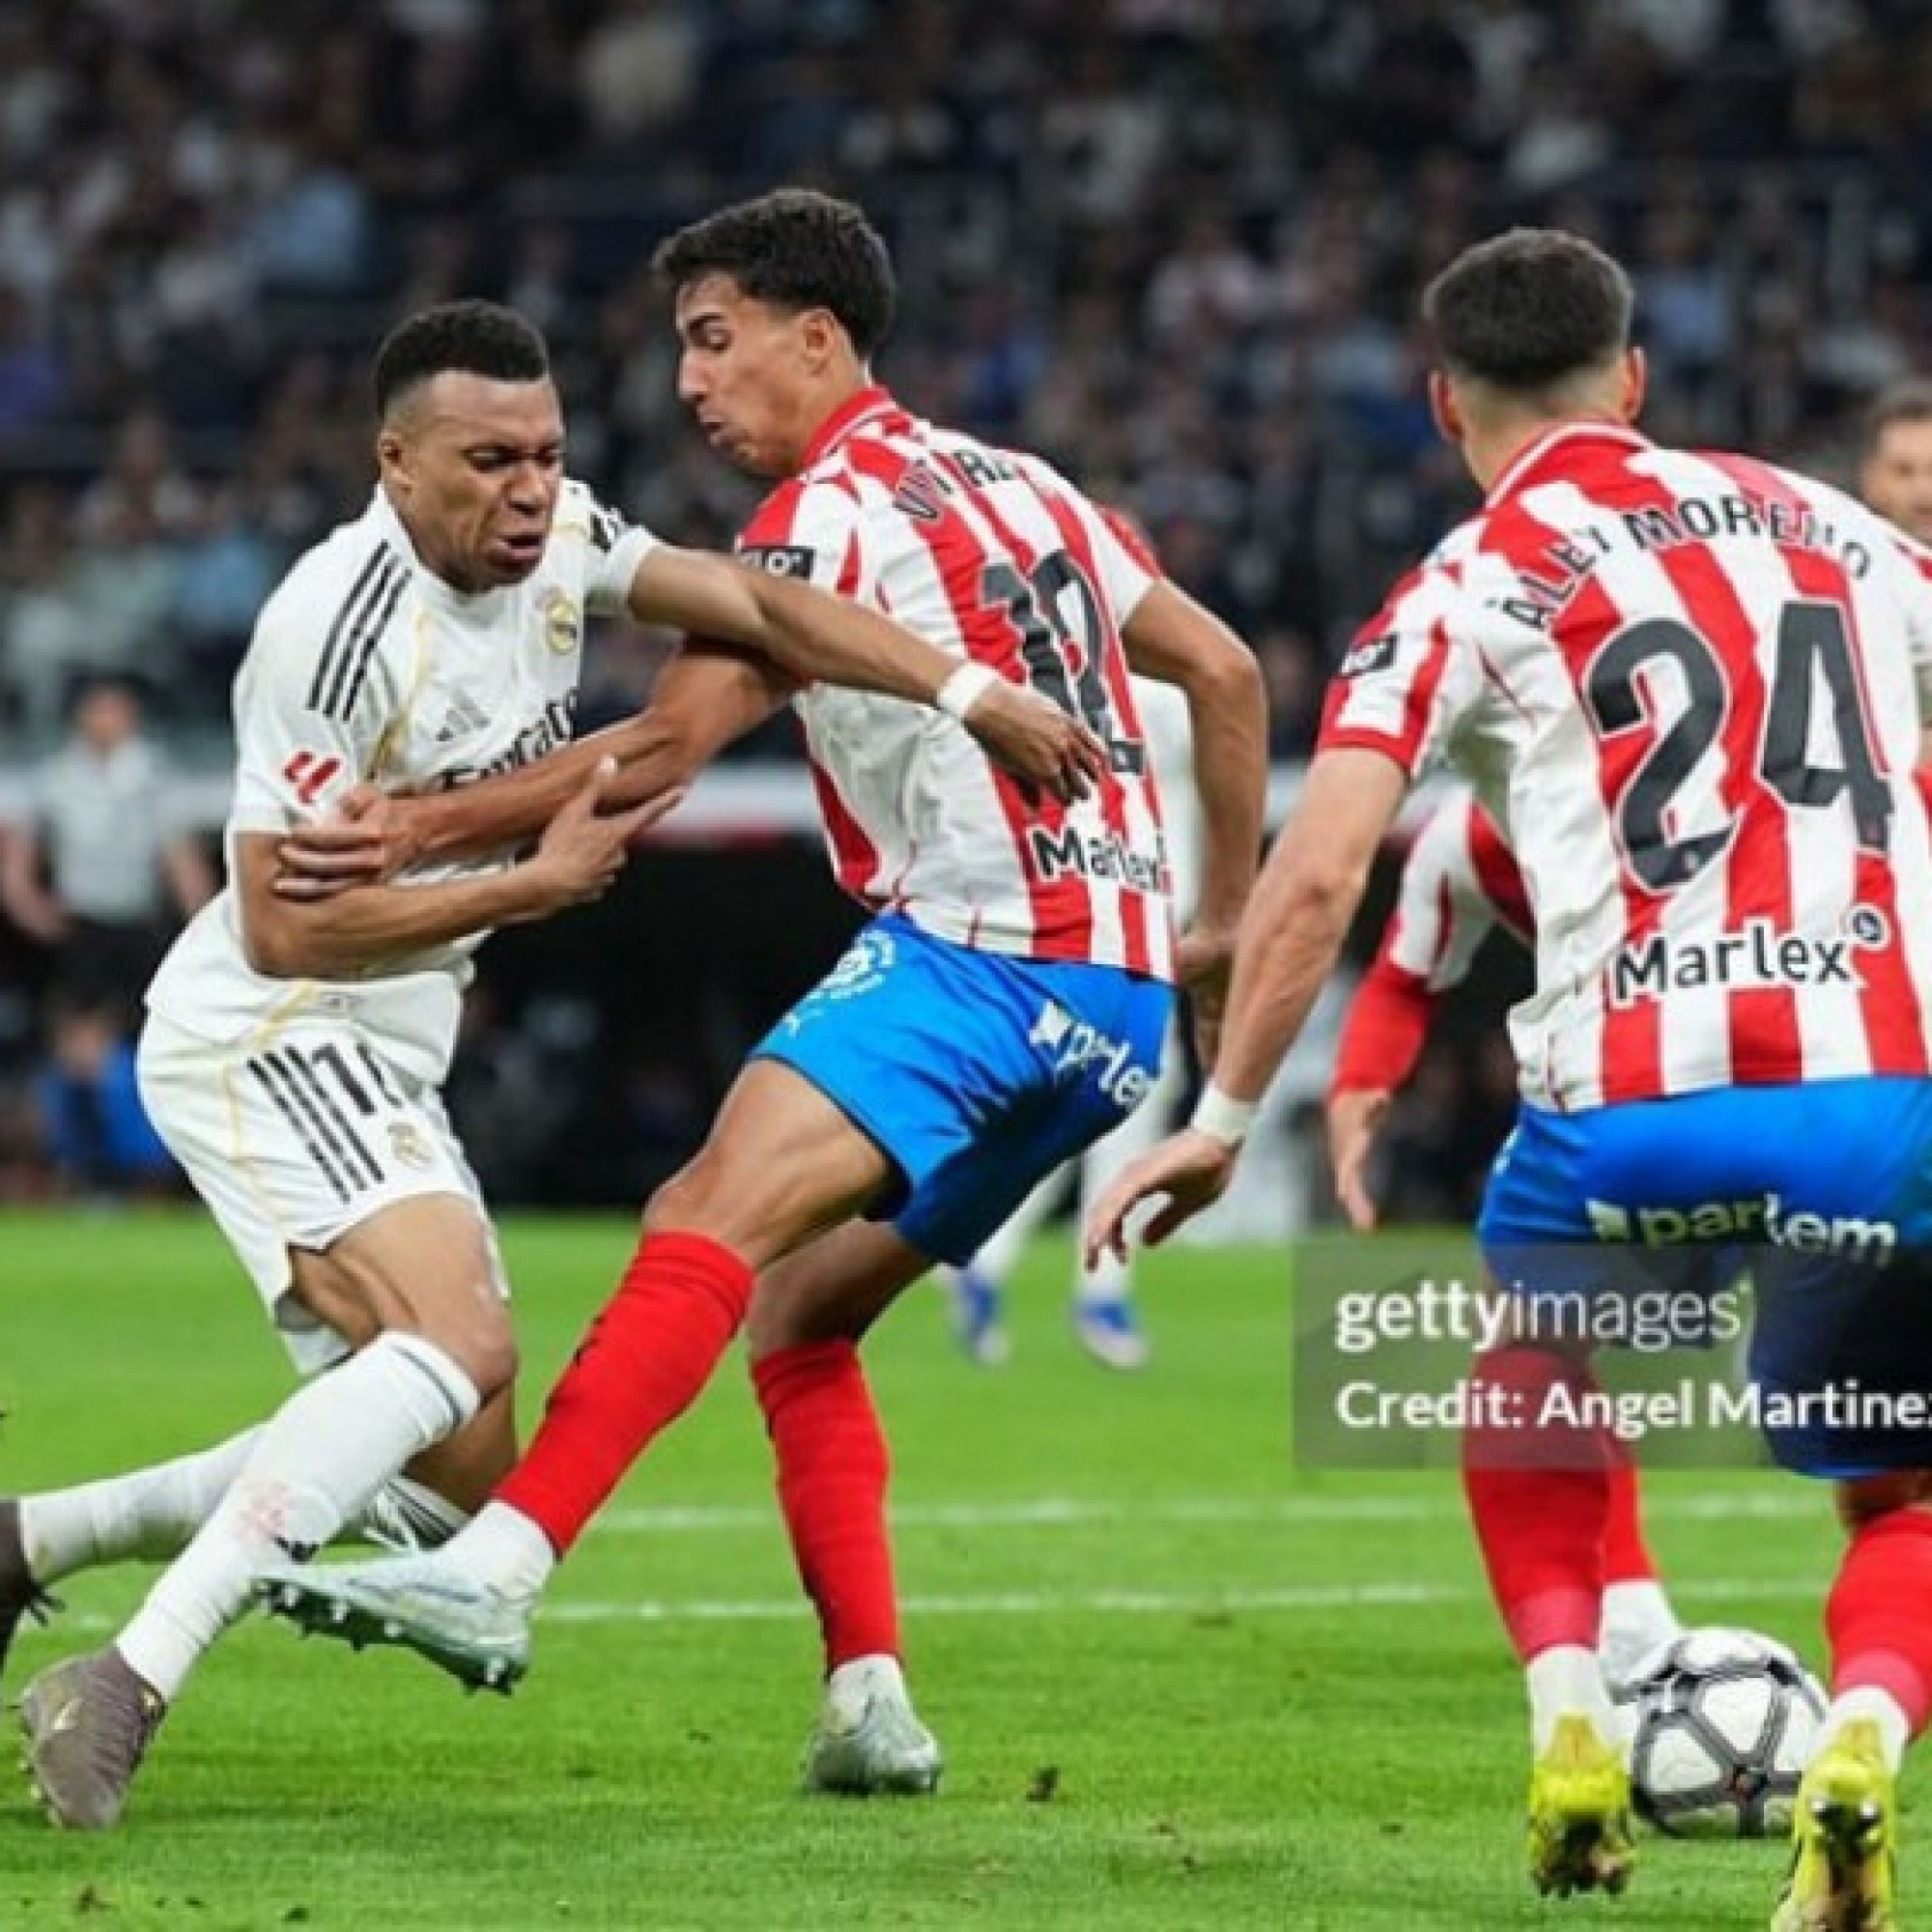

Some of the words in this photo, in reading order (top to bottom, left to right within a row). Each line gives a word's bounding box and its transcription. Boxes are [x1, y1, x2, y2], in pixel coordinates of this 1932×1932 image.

[1589, 603, 1893, 889] 24
[1616, 923, 1851, 1001] Marlex
[1638, 1192, 1896, 1267] parlem
